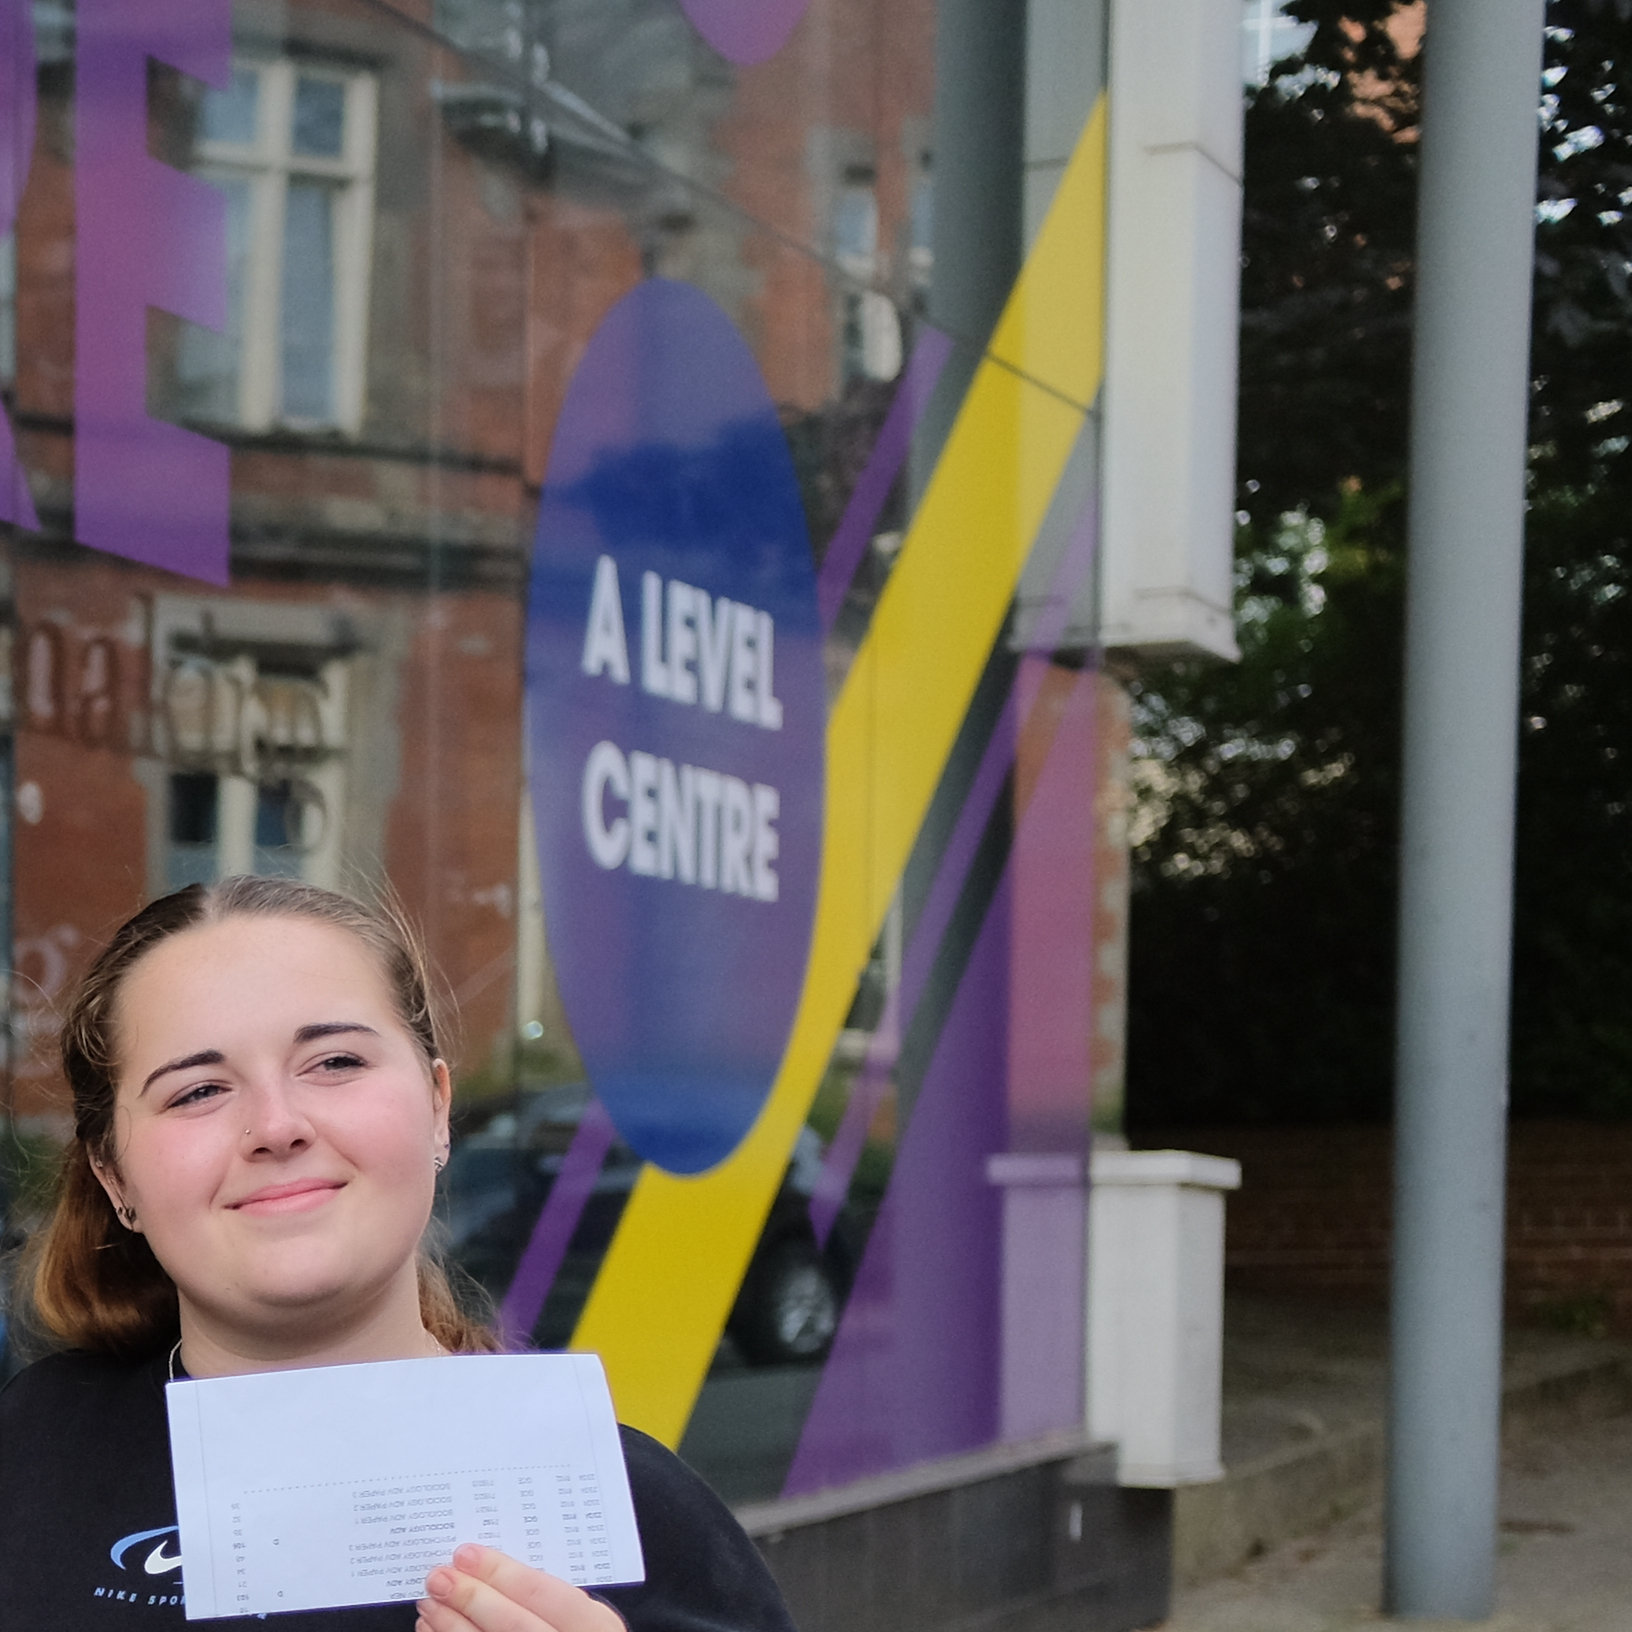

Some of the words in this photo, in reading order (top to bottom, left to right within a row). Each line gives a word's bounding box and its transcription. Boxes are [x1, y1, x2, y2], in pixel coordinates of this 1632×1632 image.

[581, 554, 630, 685] A
[640, 570, 784, 731] LEVEL
[580, 740, 780, 902] CENTRE
[93, 1587, 138, 1603] NIKE
[403, 1549, 453, 1559] SYCHOLOGY
